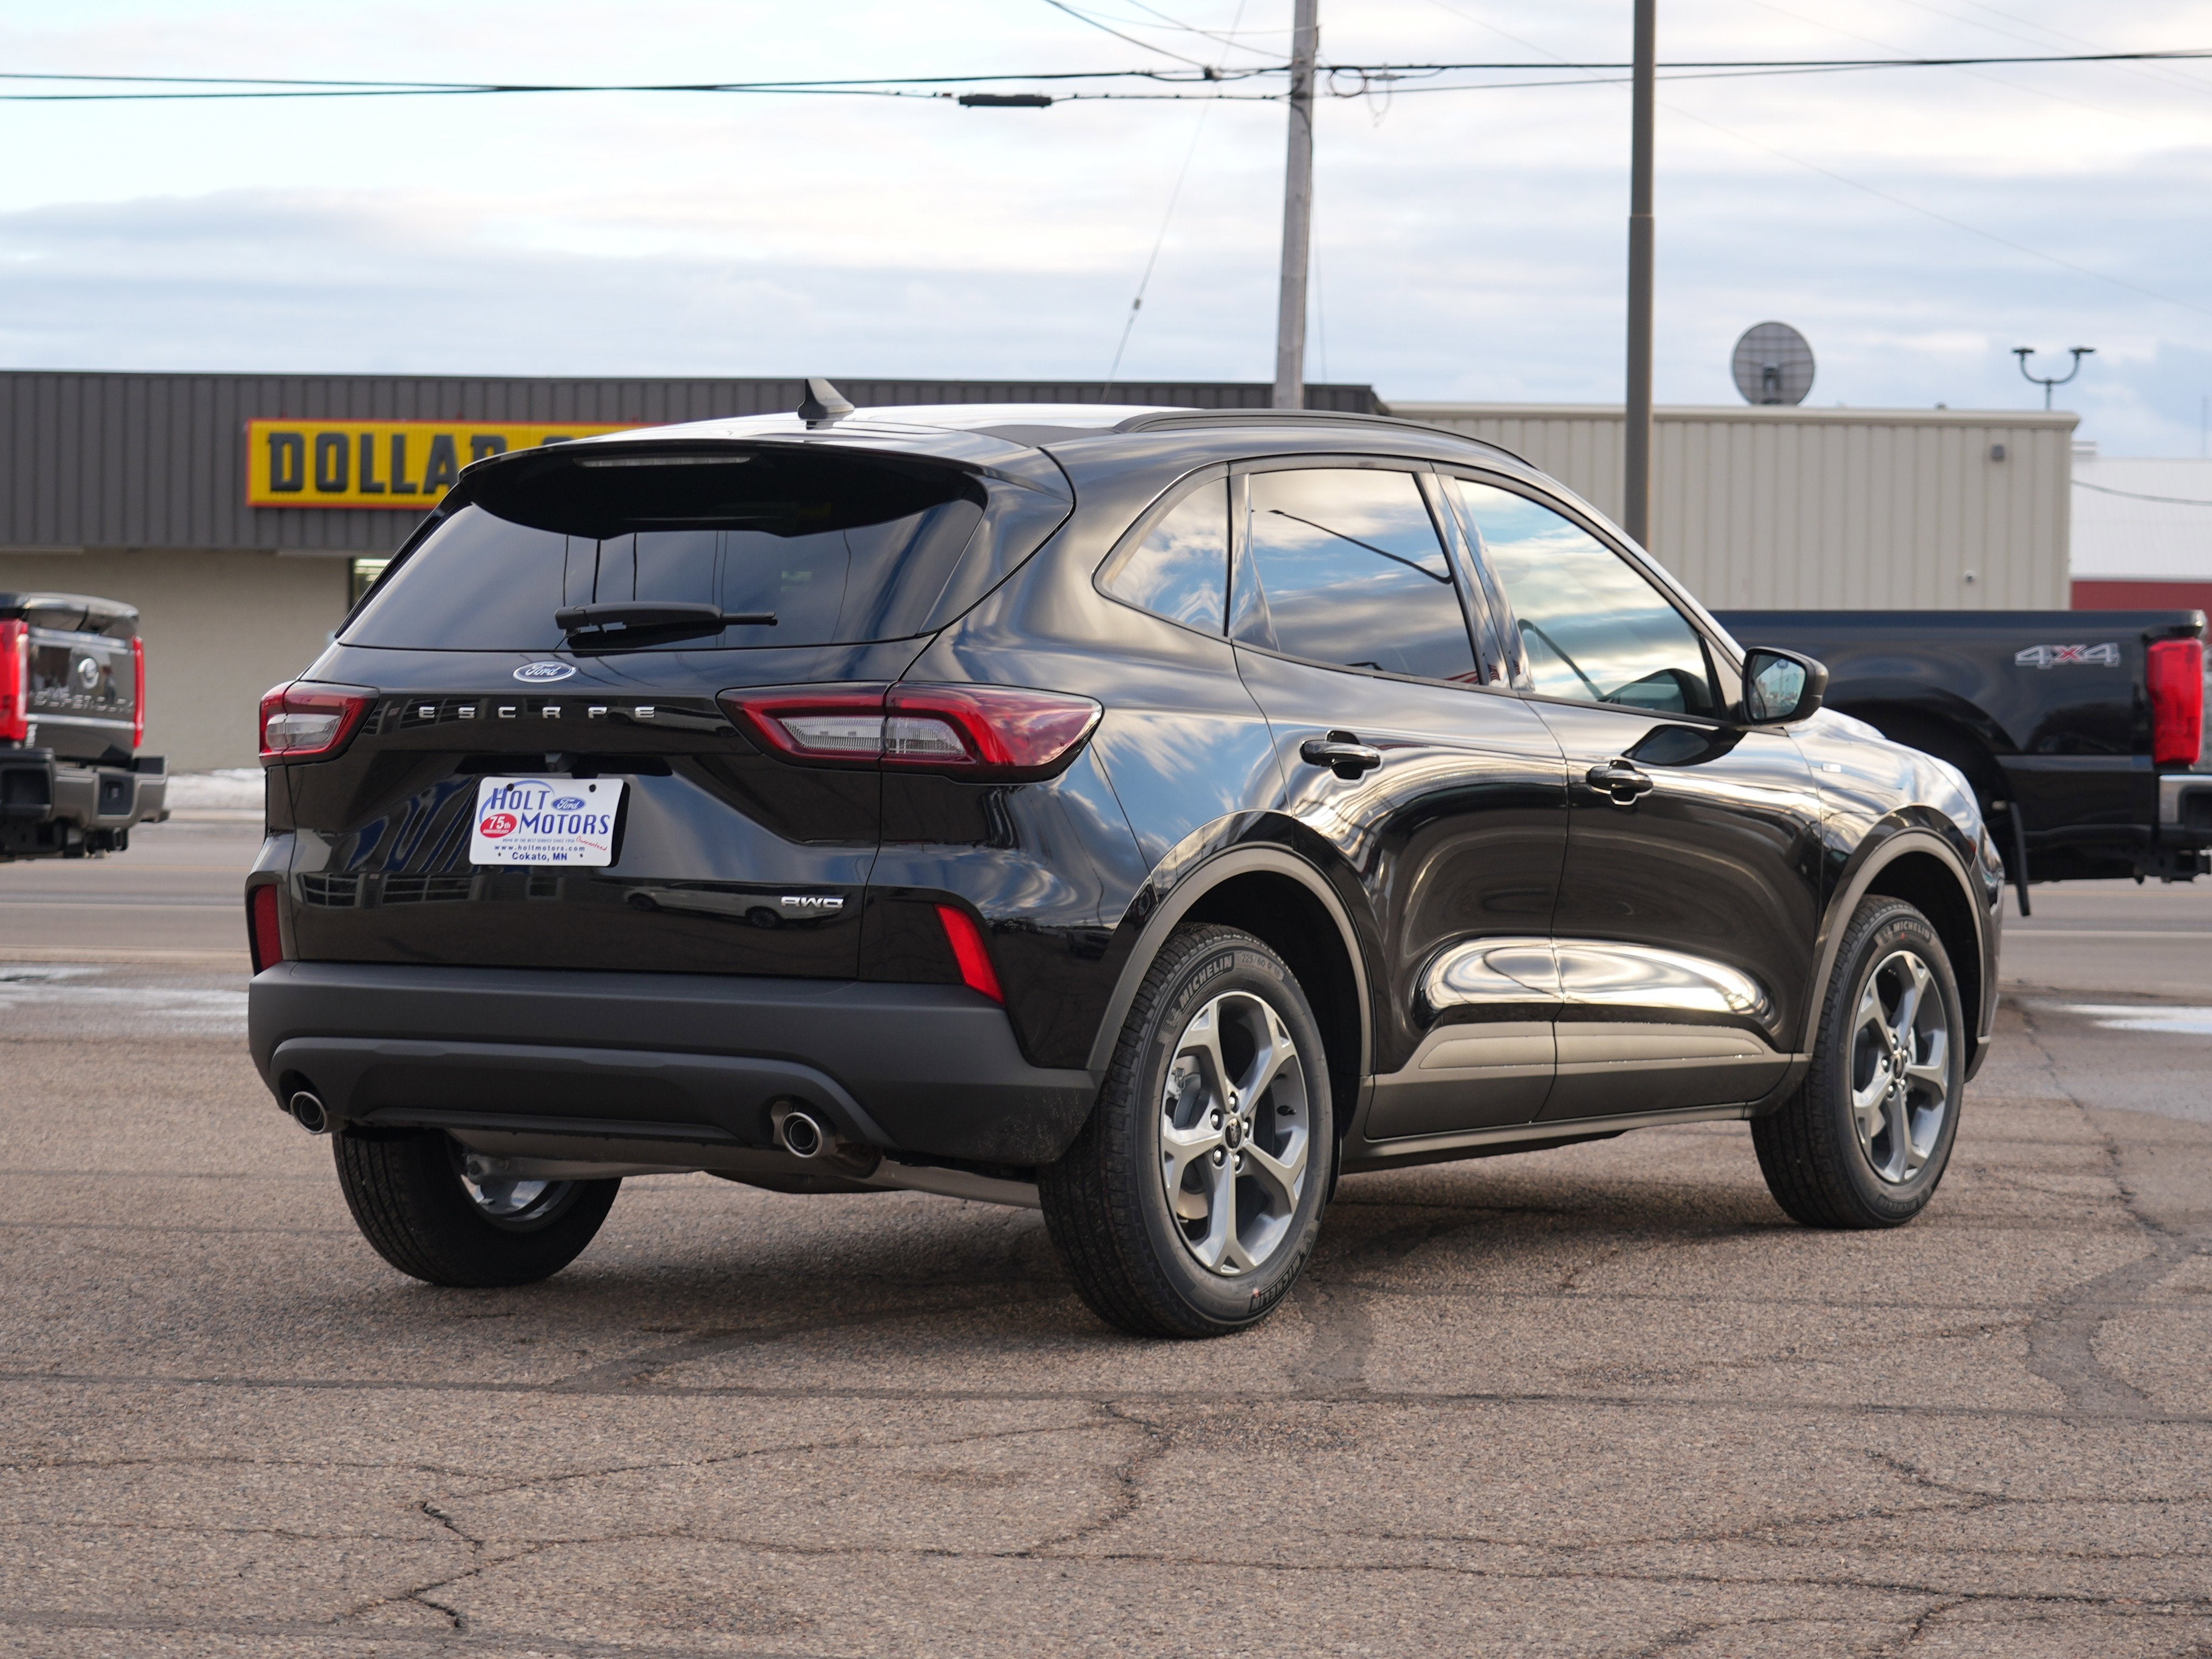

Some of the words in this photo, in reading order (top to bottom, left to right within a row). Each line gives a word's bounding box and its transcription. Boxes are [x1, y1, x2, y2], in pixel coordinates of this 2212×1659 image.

[419, 706, 656, 719] ESCAPE
[490, 787, 550, 810] HOLT
[489, 815, 511, 830] 75th
[518, 812, 610, 834] MOTORS
[512, 852, 550, 862] Cokato,
[553, 852, 568, 861] MN
[781, 896, 844, 909] AWD
[1893, 920, 1931, 941] MICHELIN
[1179, 954, 1233, 1010] MICHELIN
